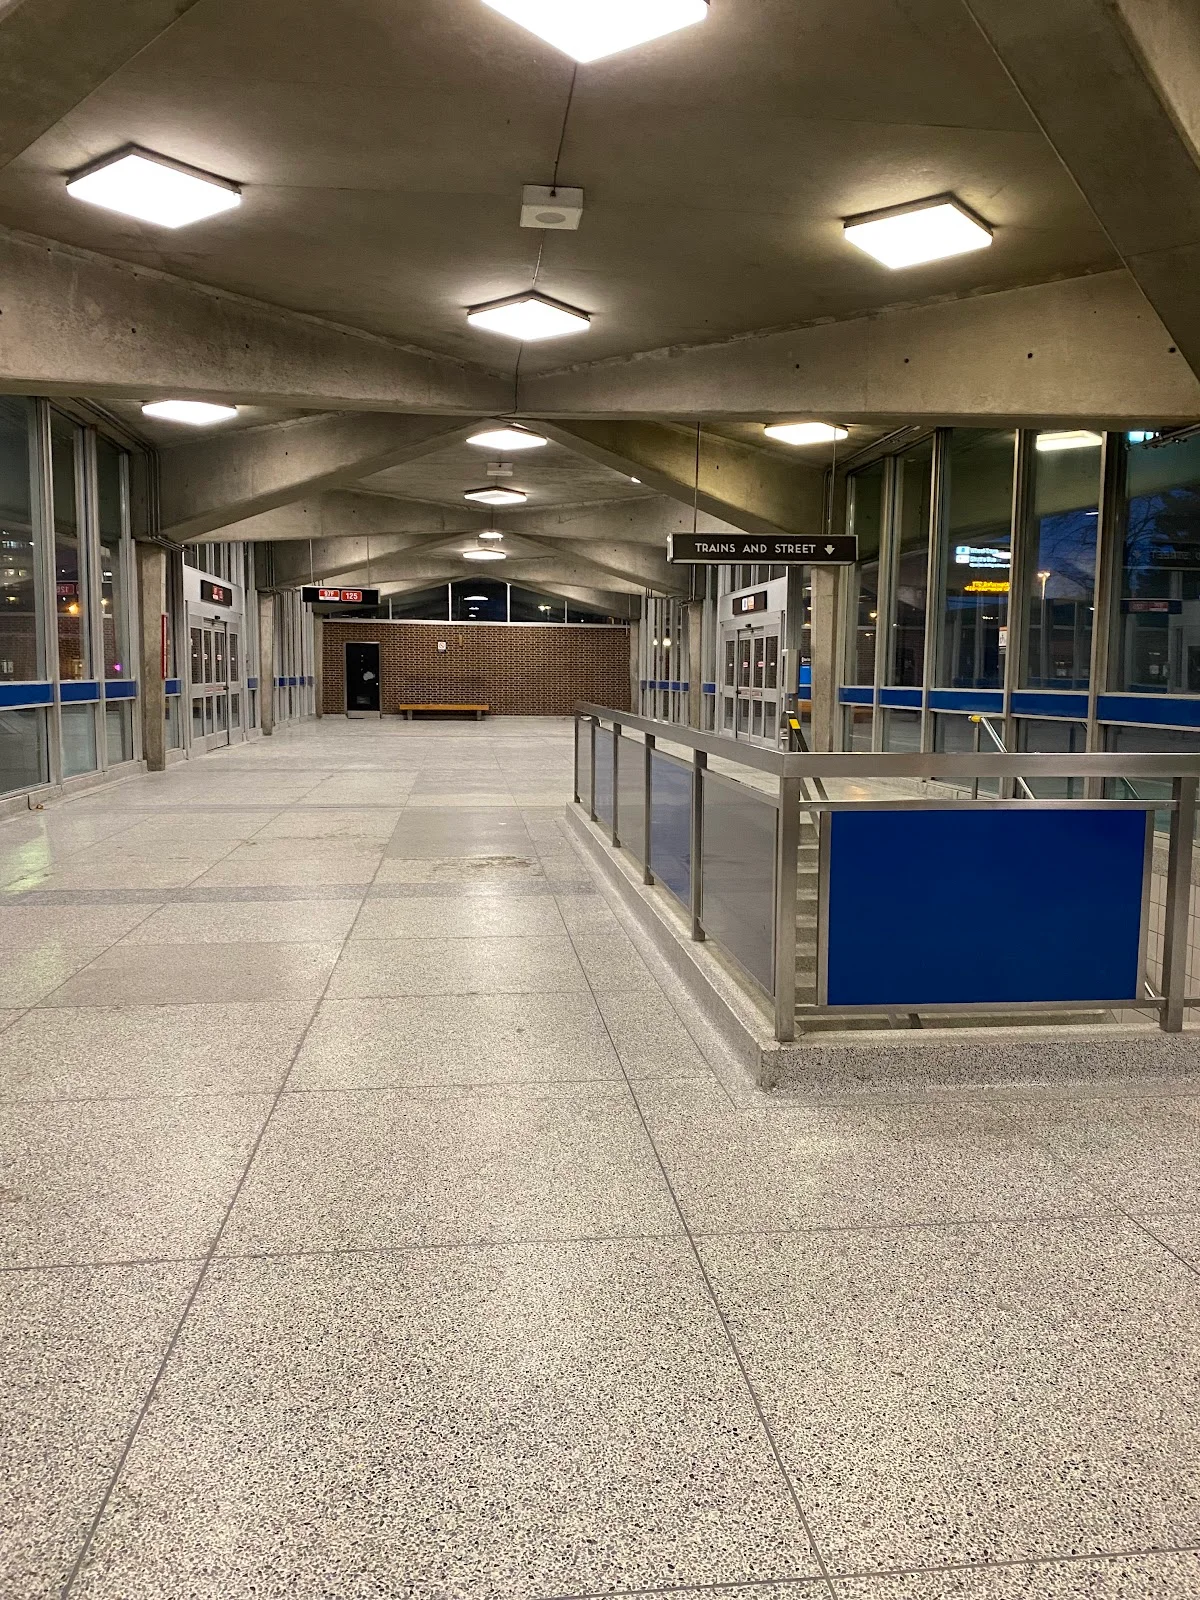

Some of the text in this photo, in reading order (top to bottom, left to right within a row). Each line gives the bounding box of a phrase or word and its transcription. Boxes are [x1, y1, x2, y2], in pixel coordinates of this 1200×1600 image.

[695, 543, 816, 554] TRAINS AND STREET
[346, 592, 358, 600] 125
